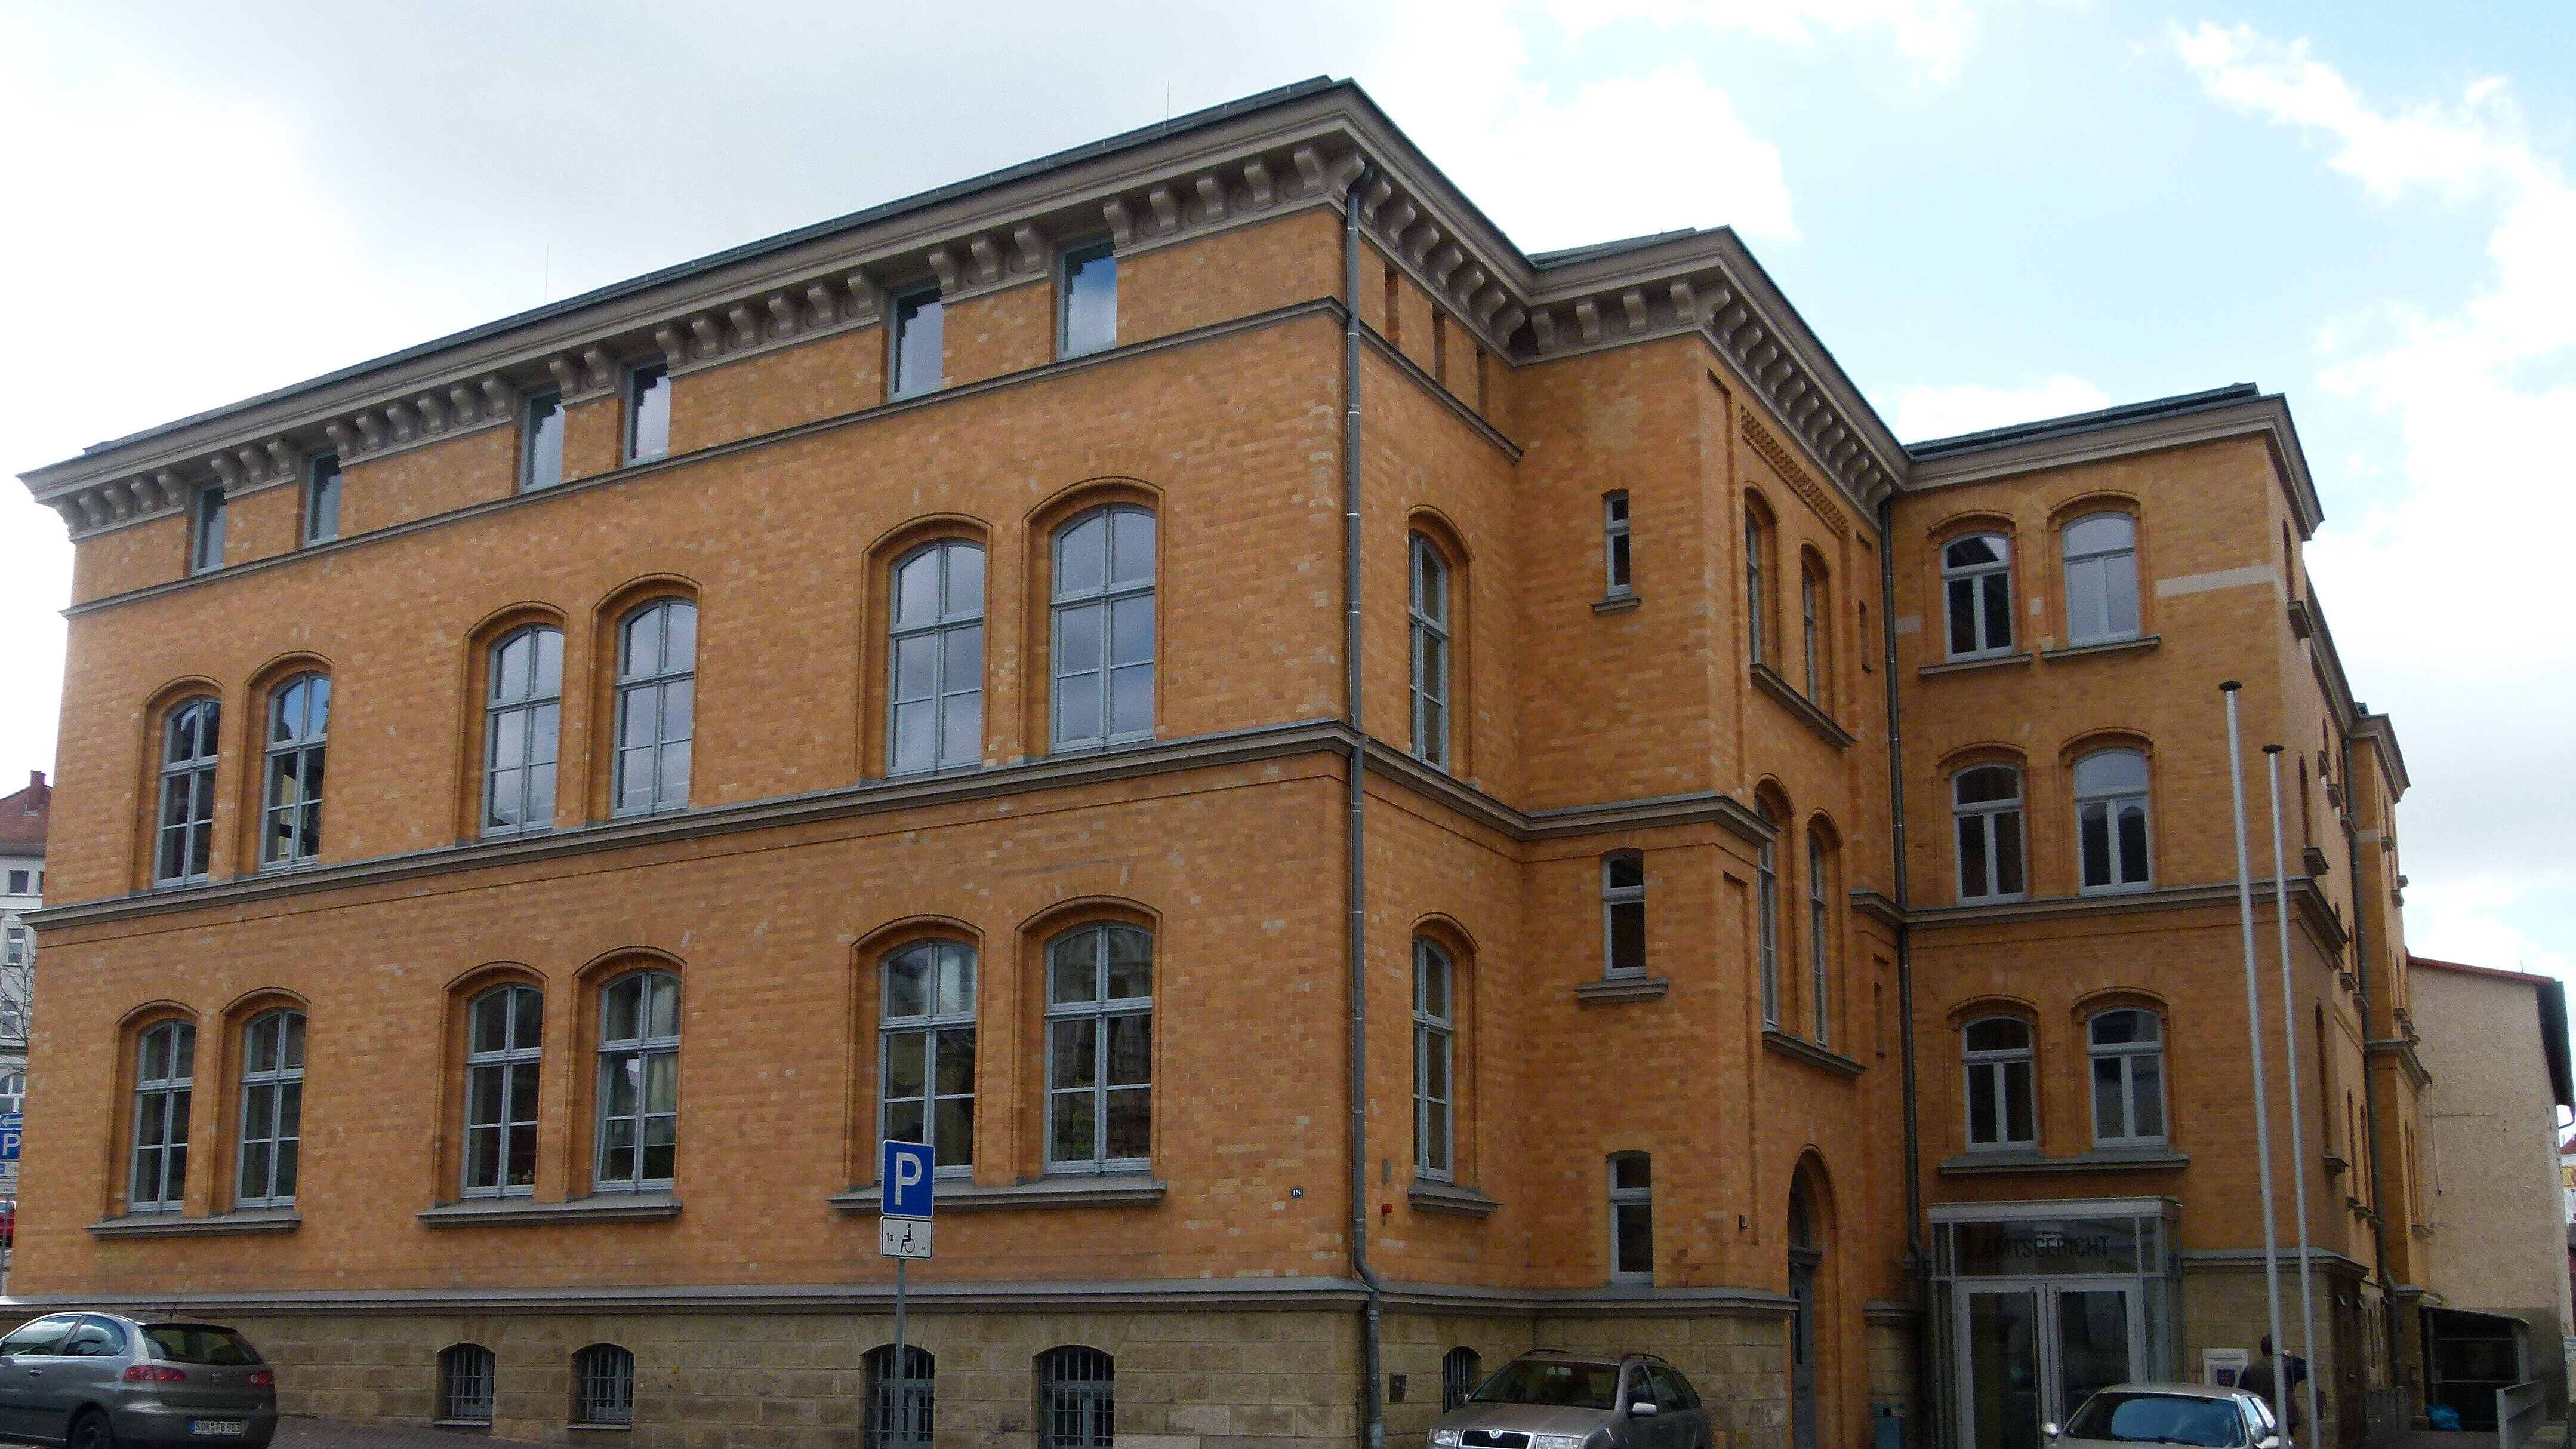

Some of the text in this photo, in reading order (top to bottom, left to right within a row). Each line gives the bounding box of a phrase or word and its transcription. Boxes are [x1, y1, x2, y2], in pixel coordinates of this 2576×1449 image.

[3, 1133, 21, 1156] P
[895, 1152, 923, 1205] P
[1982, 1236, 2109, 1258] AMTSGERICHT
